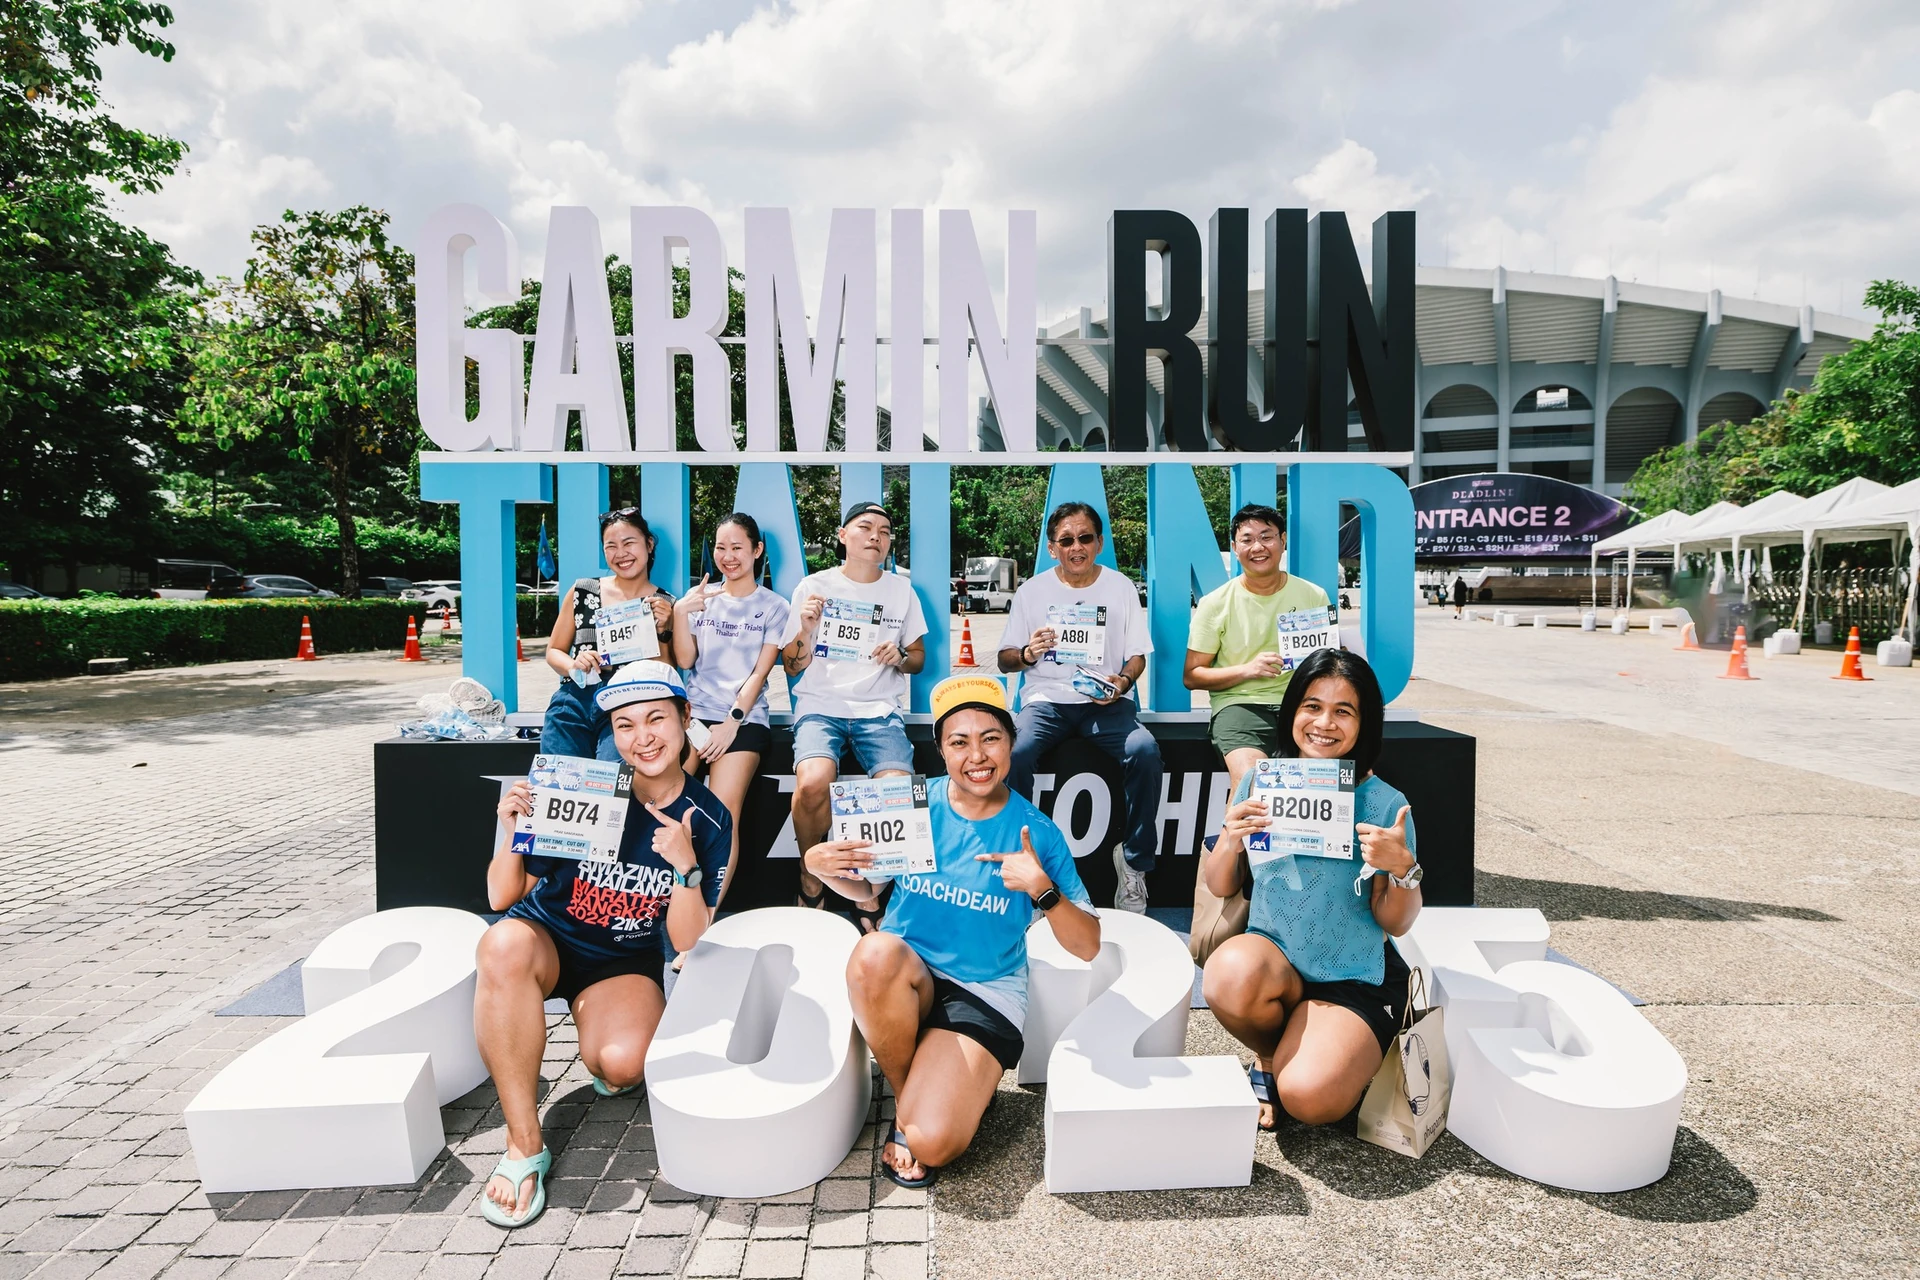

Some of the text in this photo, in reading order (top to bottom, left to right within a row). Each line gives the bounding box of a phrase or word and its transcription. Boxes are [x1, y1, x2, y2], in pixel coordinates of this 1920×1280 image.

[415, 204, 1416, 453] GARMIN RUN
[1452, 489, 1514, 499] DEADLINE
[1415, 506, 1571, 530] NTRANCE 2
[1456, 536, 1467, 544] C1
[1477, 535, 1490, 543] C3
[1497, 535, 1515, 543] E1L
[716, 629, 739, 637] Thailand
[721, 621, 738, 630] Time
[744, 623, 763, 632] Trials
[838, 625, 861, 640] B35
[1061, 629, 1088, 643] A881
[1292, 632, 1328, 649] B2017
[600, 689, 621, 702] ALWAYS
[935, 684, 957, 702] ALWAYS
[966, 680, 998, 692] YOURSELF
[617, 783, 631, 792] KM
[1340, 777, 1353, 785] KM
[915, 793, 927, 802] KM
[546, 797, 600, 825] B974
[1272, 796, 1333, 822] B2018
[841, 822, 847, 833] F
[860, 819, 906, 844] B102
[511, 842, 530, 853] AXA
[1250, 841, 1267, 850] AXA
[578, 860, 673, 885] AMAZING
[579, 868, 673, 897] THAILAND
[573, 877, 671, 907] MARATH
[902, 873, 1010, 916] COACHDEAW
[571, 889, 660, 919] BANGKOK
[566, 900, 645, 931] 2024 21K
